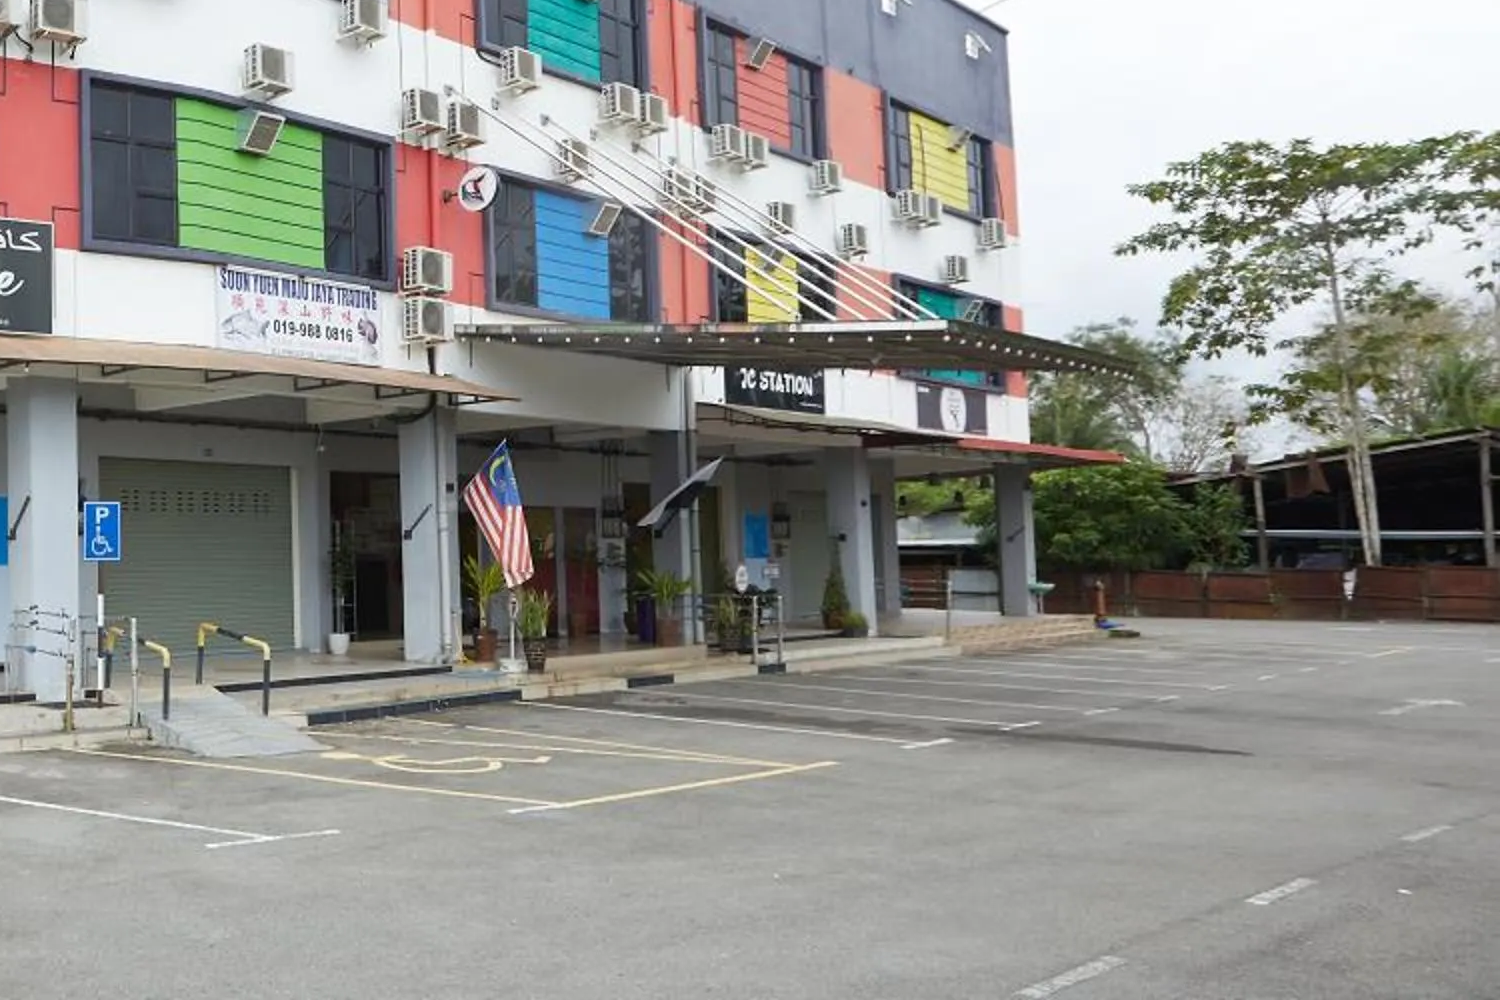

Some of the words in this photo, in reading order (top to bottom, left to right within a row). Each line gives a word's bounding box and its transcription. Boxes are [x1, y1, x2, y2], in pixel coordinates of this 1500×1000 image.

[220, 267, 251, 292] SOON
[252, 273, 279, 297] YUEN
[281, 277, 309, 301] MAJU
[759, 370, 813, 397] STATION
[95, 506, 110, 525] P
